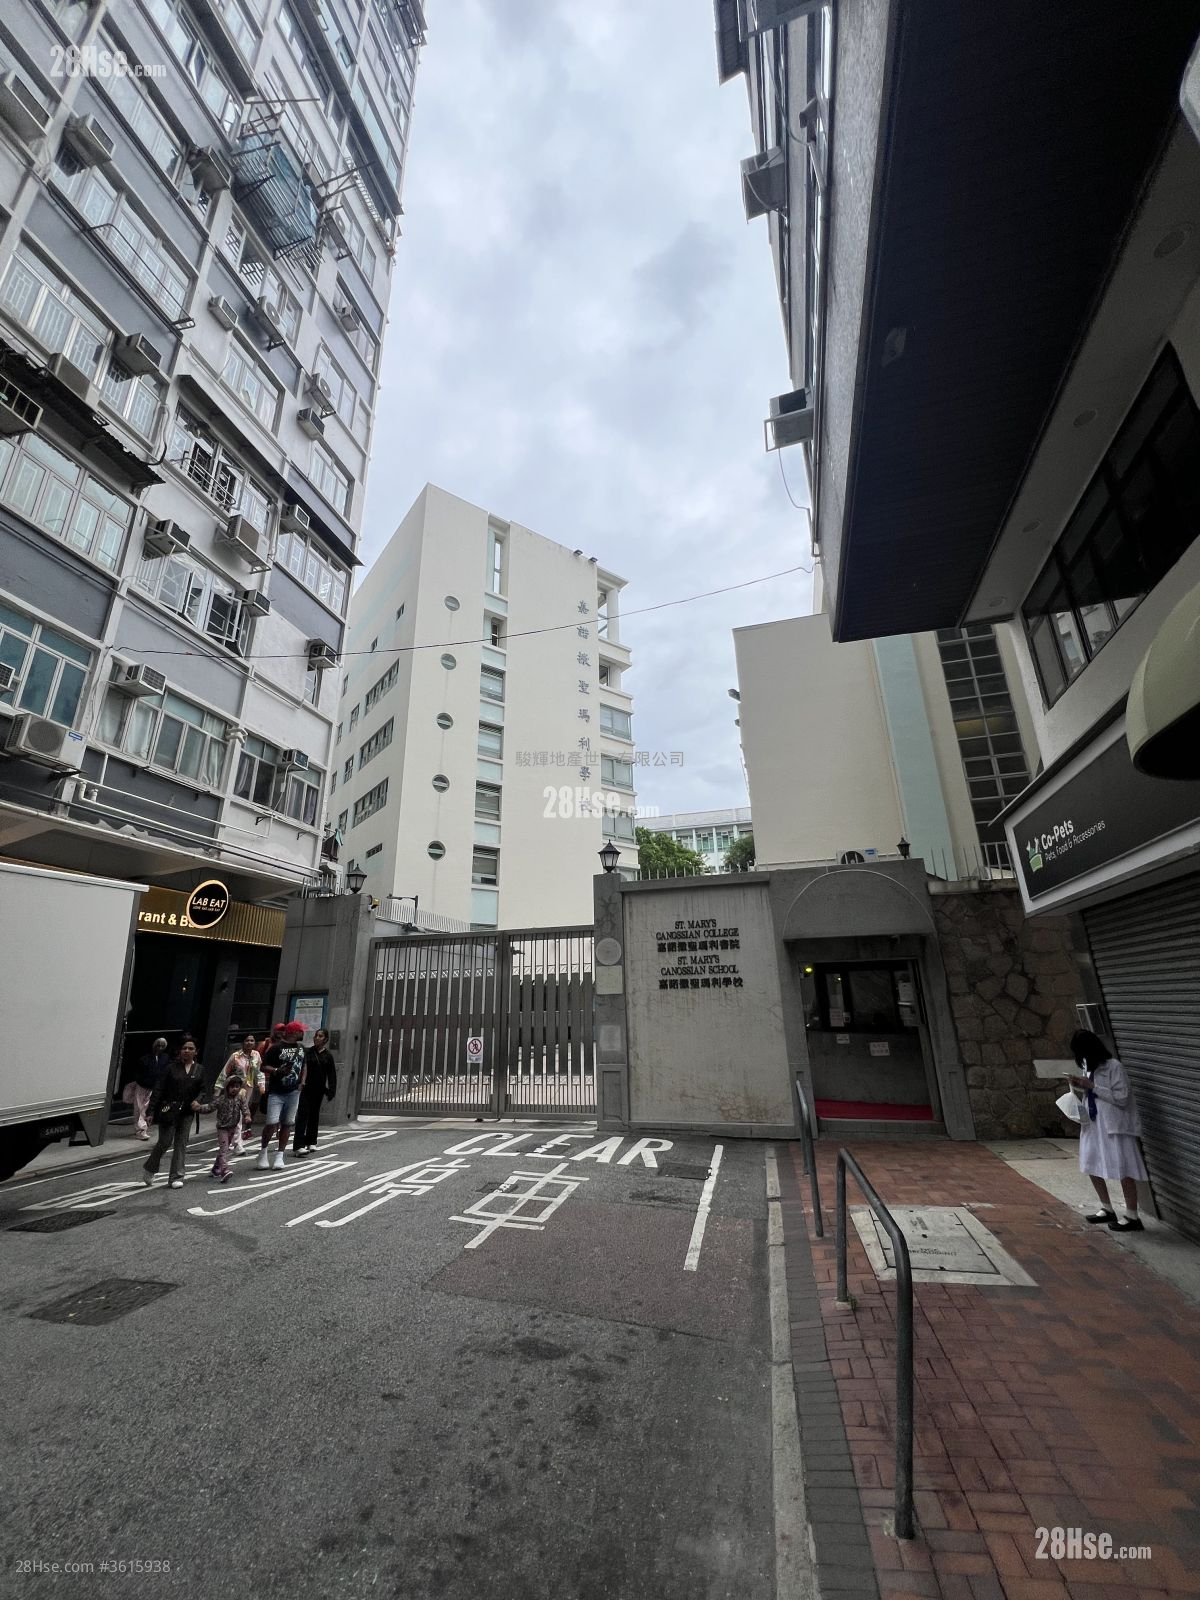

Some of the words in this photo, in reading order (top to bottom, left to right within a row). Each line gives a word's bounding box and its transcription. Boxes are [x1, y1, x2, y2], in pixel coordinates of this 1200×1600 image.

[1041, 820, 1074, 850] Co-Pets
[192, 896, 209, 907] LAB
[209, 899, 226, 908] EAT
[168, 913, 177, 926] &
[675, 921, 686, 930] ST.
[688, 919, 717, 929] MARY'S
[656, 930, 701, 941] CANOSSIAN
[704, 928, 739, 938] COLLEGE
[678, 956, 688, 965] ST.
[690, 955, 720, 965] MARY'S
[661, 966, 706, 976] CANOSSIAN
[708, 965, 739, 974] SCHOOL
[443, 1133, 674, 1168] CLEAR
